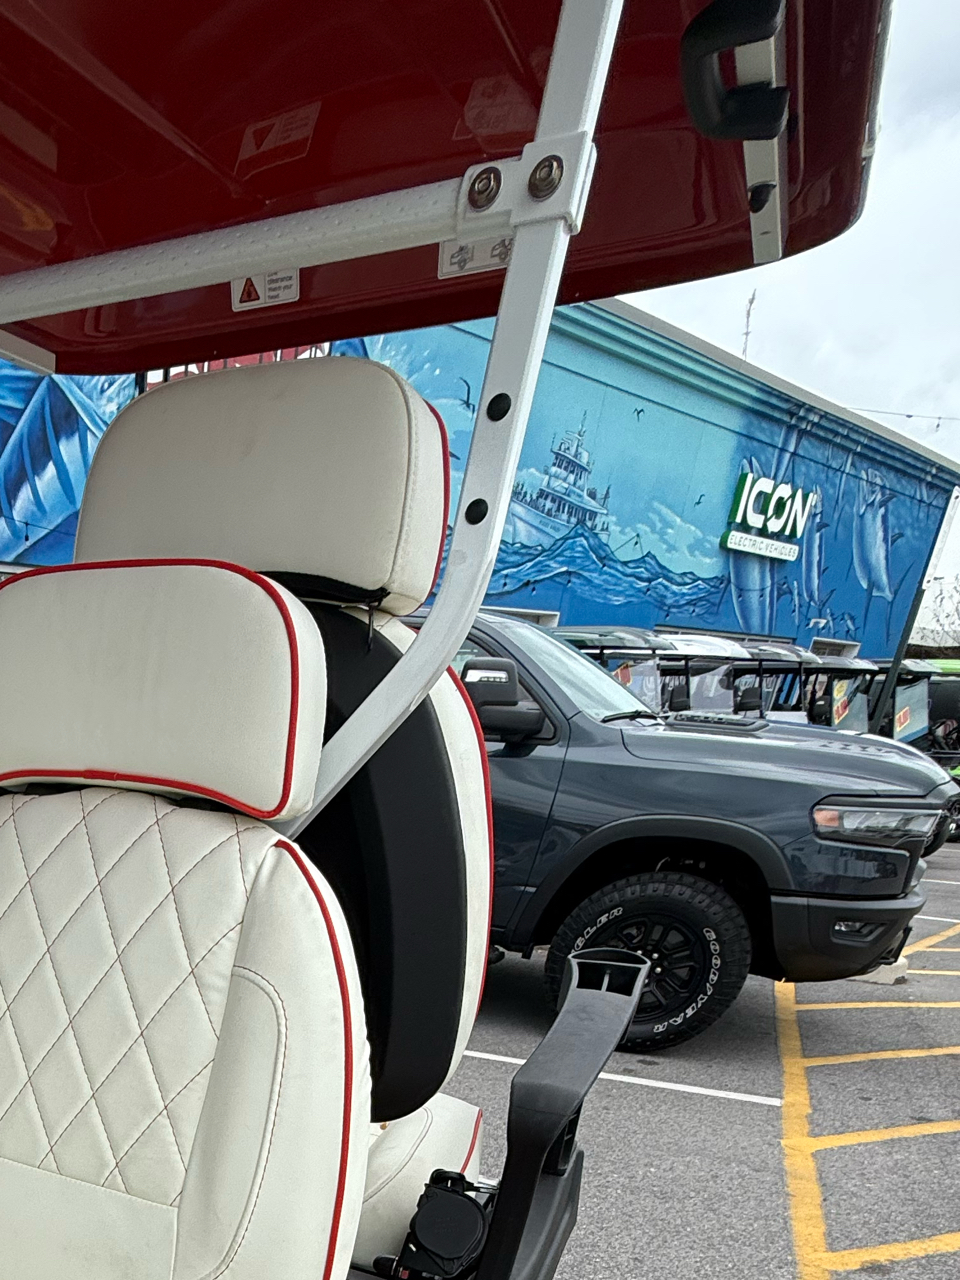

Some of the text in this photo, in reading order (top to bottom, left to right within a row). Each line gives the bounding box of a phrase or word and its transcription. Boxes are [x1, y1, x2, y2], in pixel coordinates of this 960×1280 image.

[734, 472, 815, 540] ICON
[728, 533, 798, 559] ELECTRIC VEHICLES
[652, 926, 722, 1034] GOODYEAR
